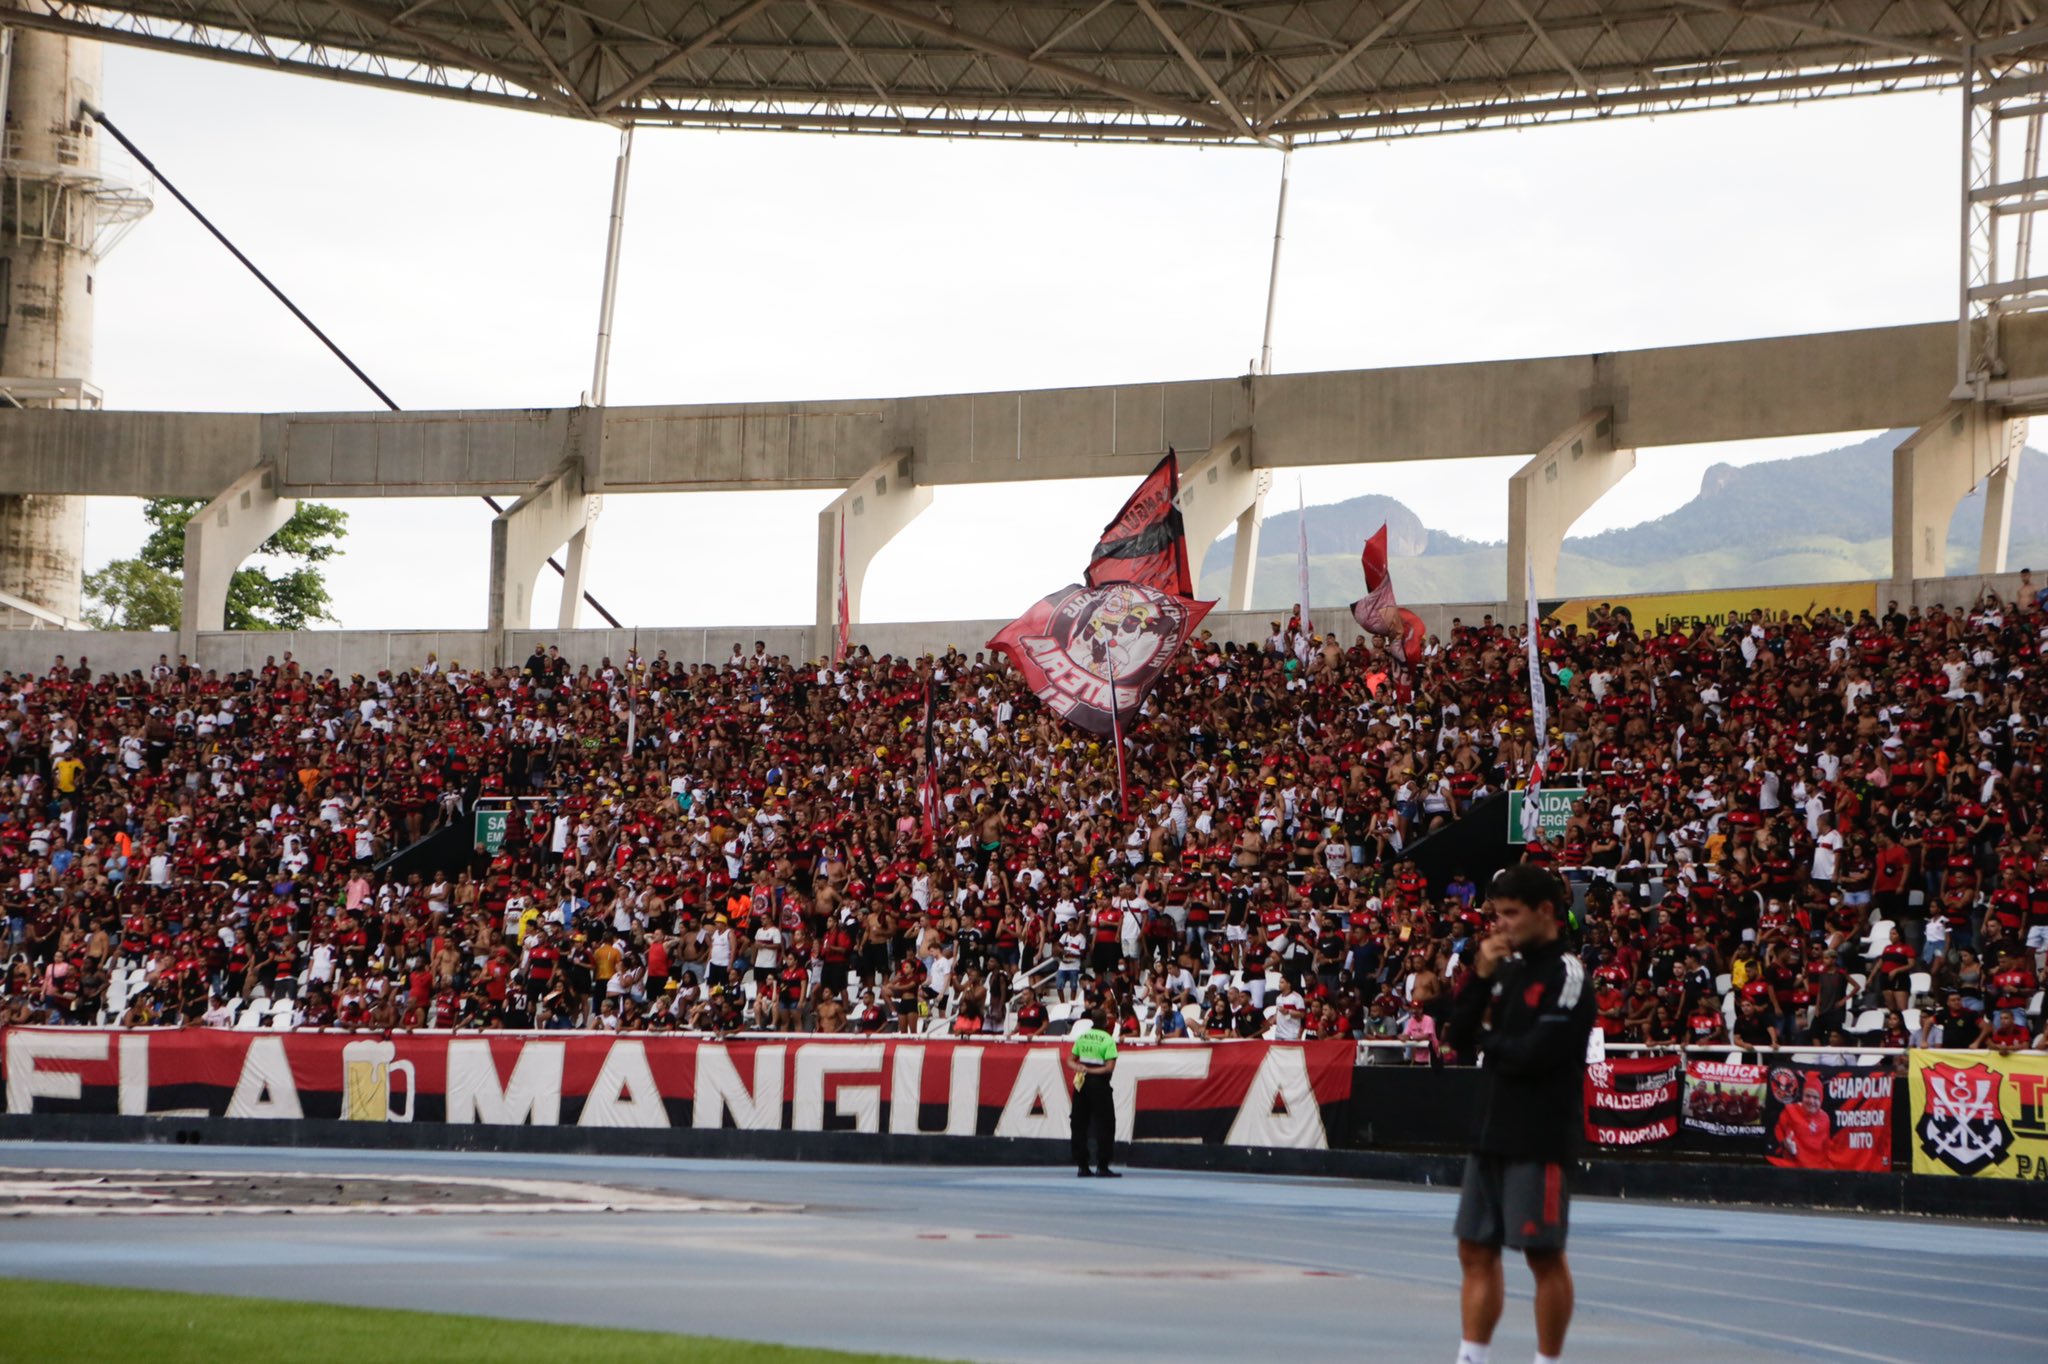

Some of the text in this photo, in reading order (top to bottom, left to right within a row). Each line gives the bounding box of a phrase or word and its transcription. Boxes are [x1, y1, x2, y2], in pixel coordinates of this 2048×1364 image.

[6, 1031, 305, 1119] FLA
[1696, 1061, 1760, 1079] SAMUCA
[1596, 1087, 1669, 1110] KALDEIRÃO
[1829, 1076, 1892, 1099] CHAPOLIN
[1835, 1110, 1885, 1127] TORCEDOR
[1599, 1122, 1670, 1145] DO NORMA
[1849, 1132, 1873, 1149] MITO
